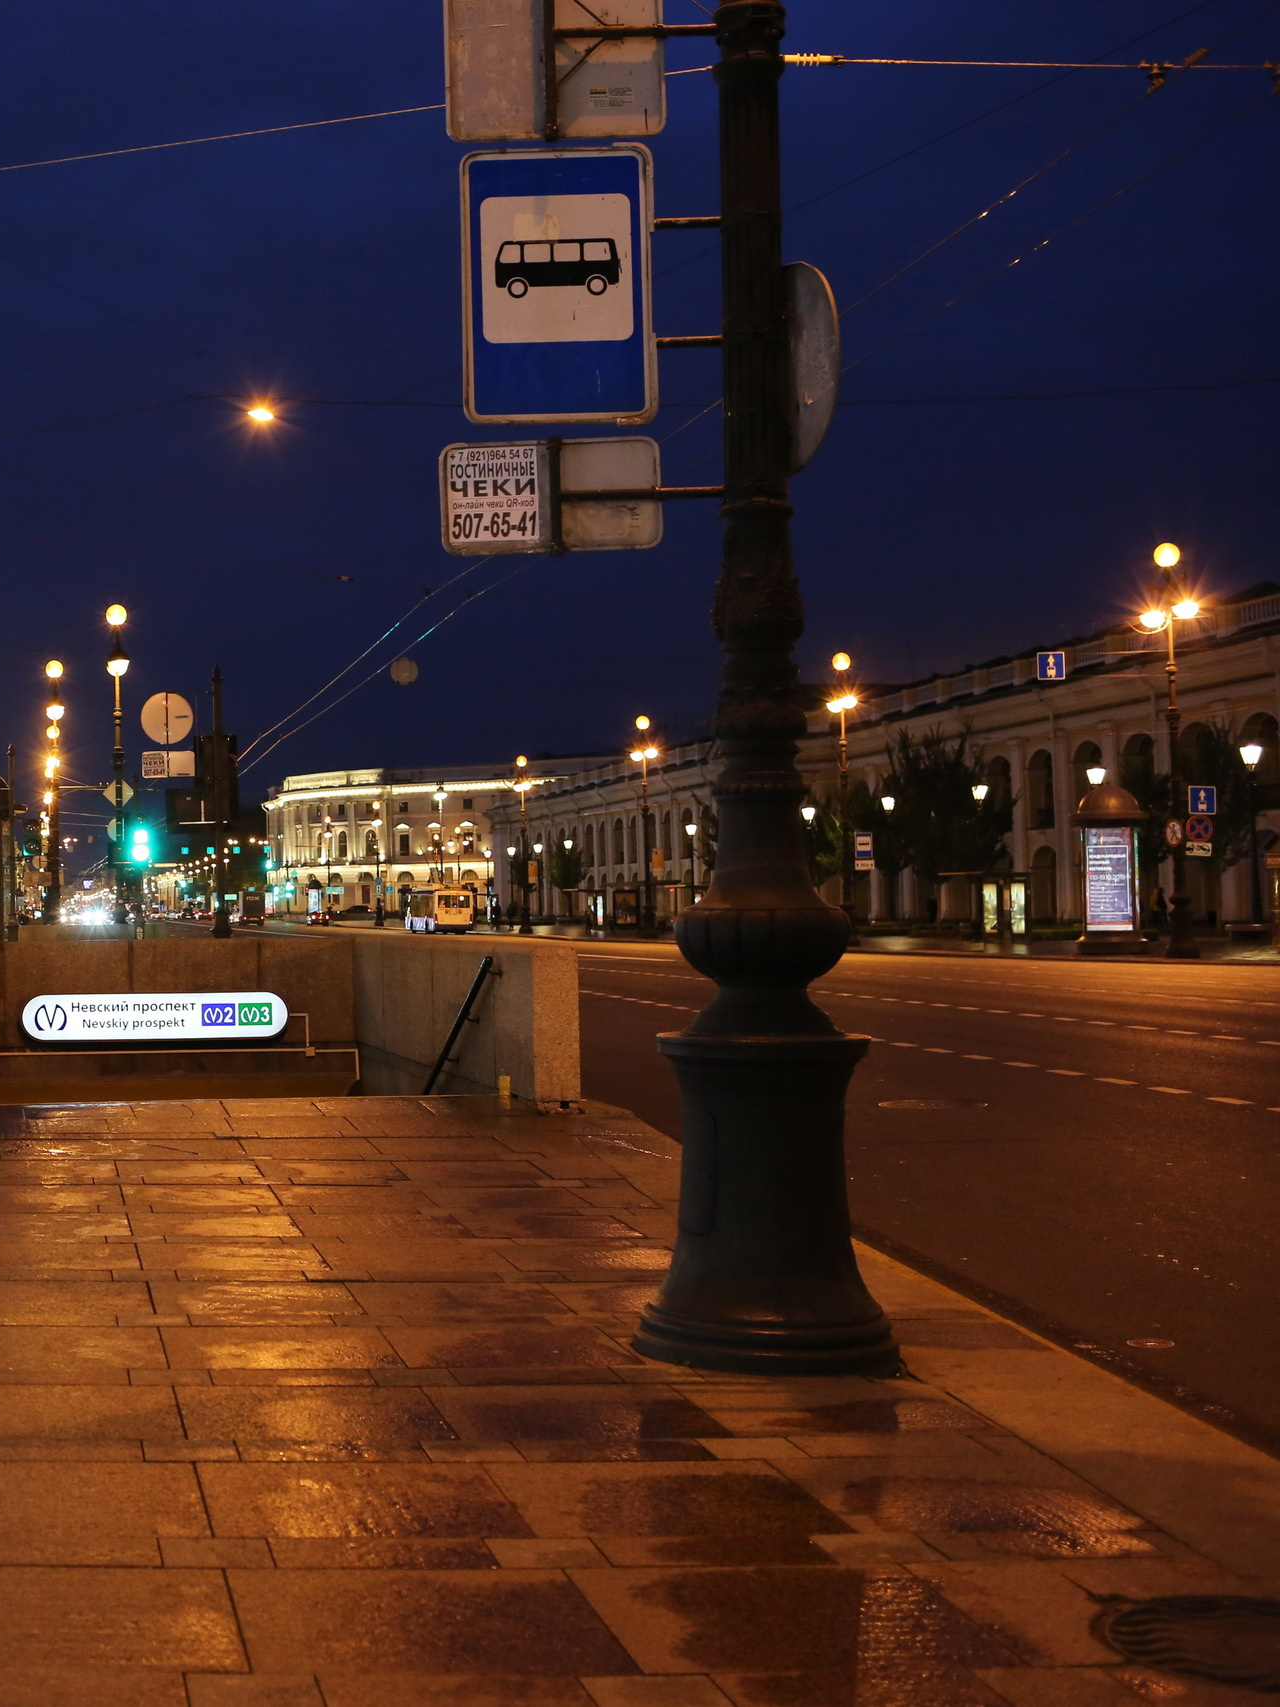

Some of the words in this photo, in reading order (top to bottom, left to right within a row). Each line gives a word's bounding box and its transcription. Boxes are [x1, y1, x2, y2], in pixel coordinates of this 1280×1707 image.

[458, 452, 464, 461] 7
[467, 450, 506, 463] (921)964
[510, 449, 520, 459] 54
[523, 448, 534, 458] 67
[450, 461, 535, 479] ГОСТИНИЧНЫЕ
[450, 478, 536, 497] ЧЕКИ
[487, 501, 504, 509] чеки
[506, 498, 535, 508] QR-код
[452, 511, 537, 540] 507-65-41
[71, 1000, 130, 1013] Невский
[132, 1002, 197, 1016] проспект
[82, 1018, 128, 1031] Nevskiy
[132, 1017, 186, 1030] prospekt
